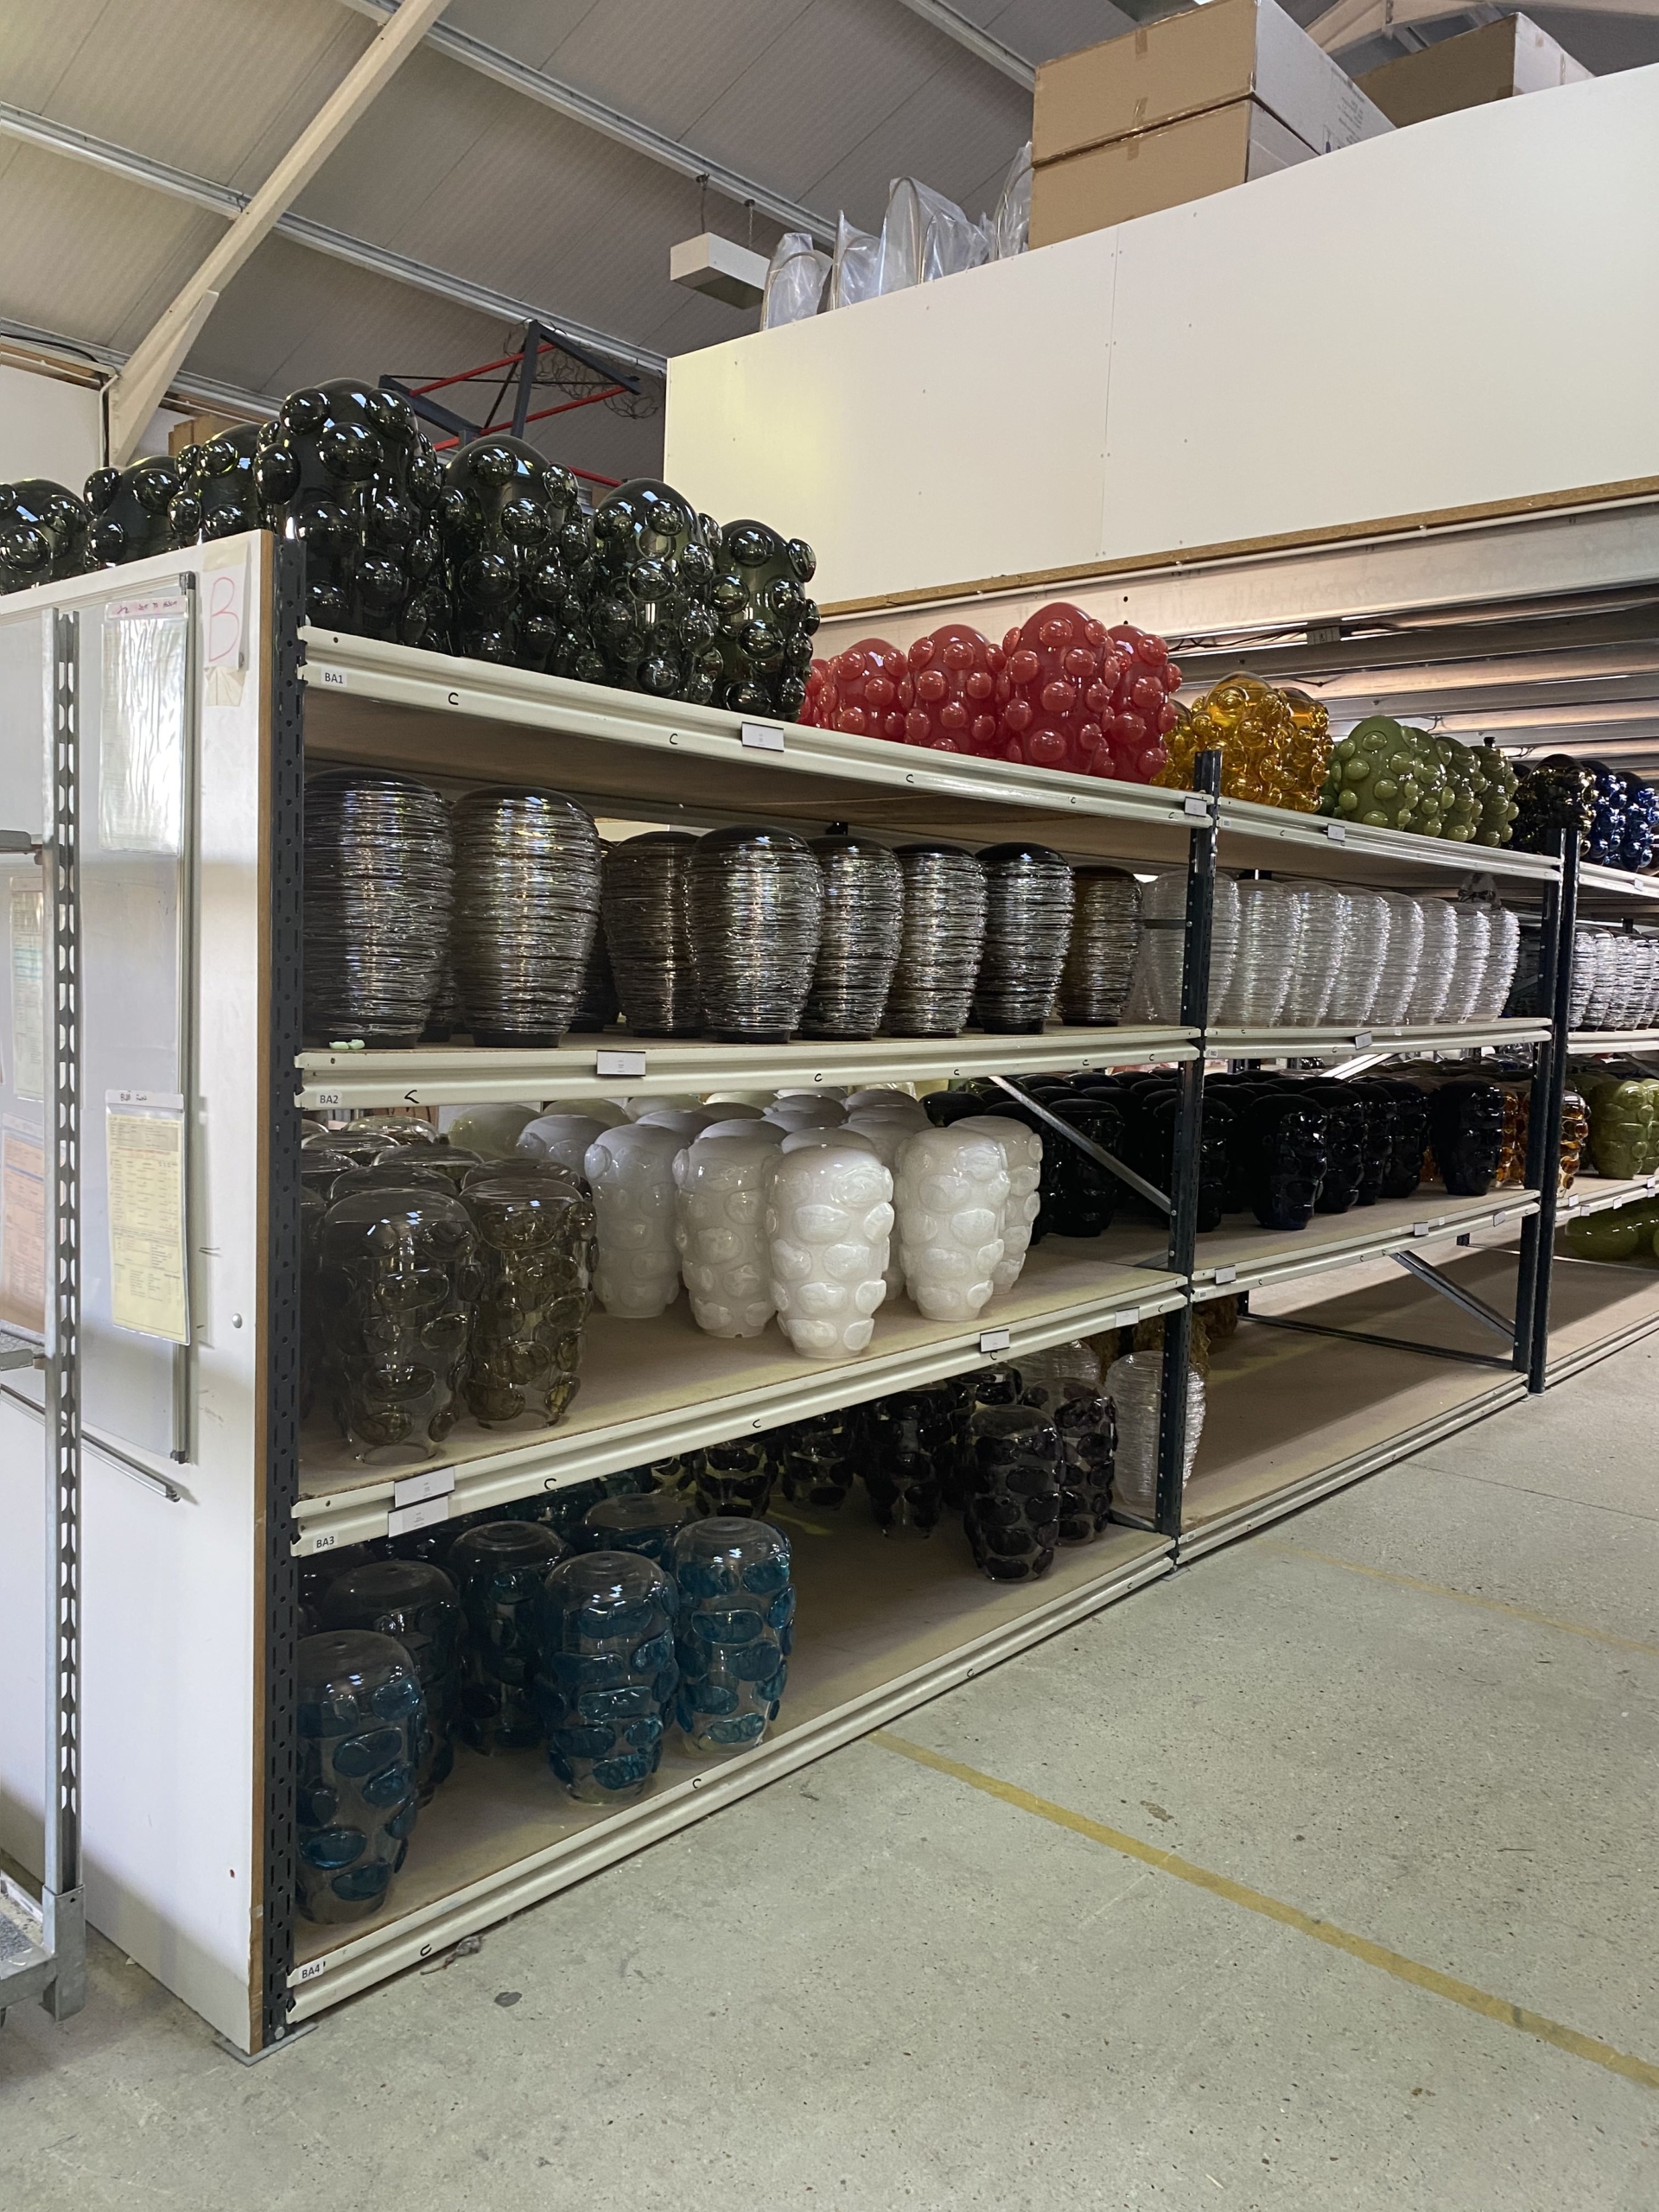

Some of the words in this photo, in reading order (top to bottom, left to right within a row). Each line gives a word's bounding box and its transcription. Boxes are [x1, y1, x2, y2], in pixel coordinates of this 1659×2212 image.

[208, 576, 240, 663] B
[325, 672, 344, 684] BA1
[320, 1094, 339, 1104] BA2
[316, 1535, 335, 1548] BA3
[302, 1964, 321, 1979] BA4
